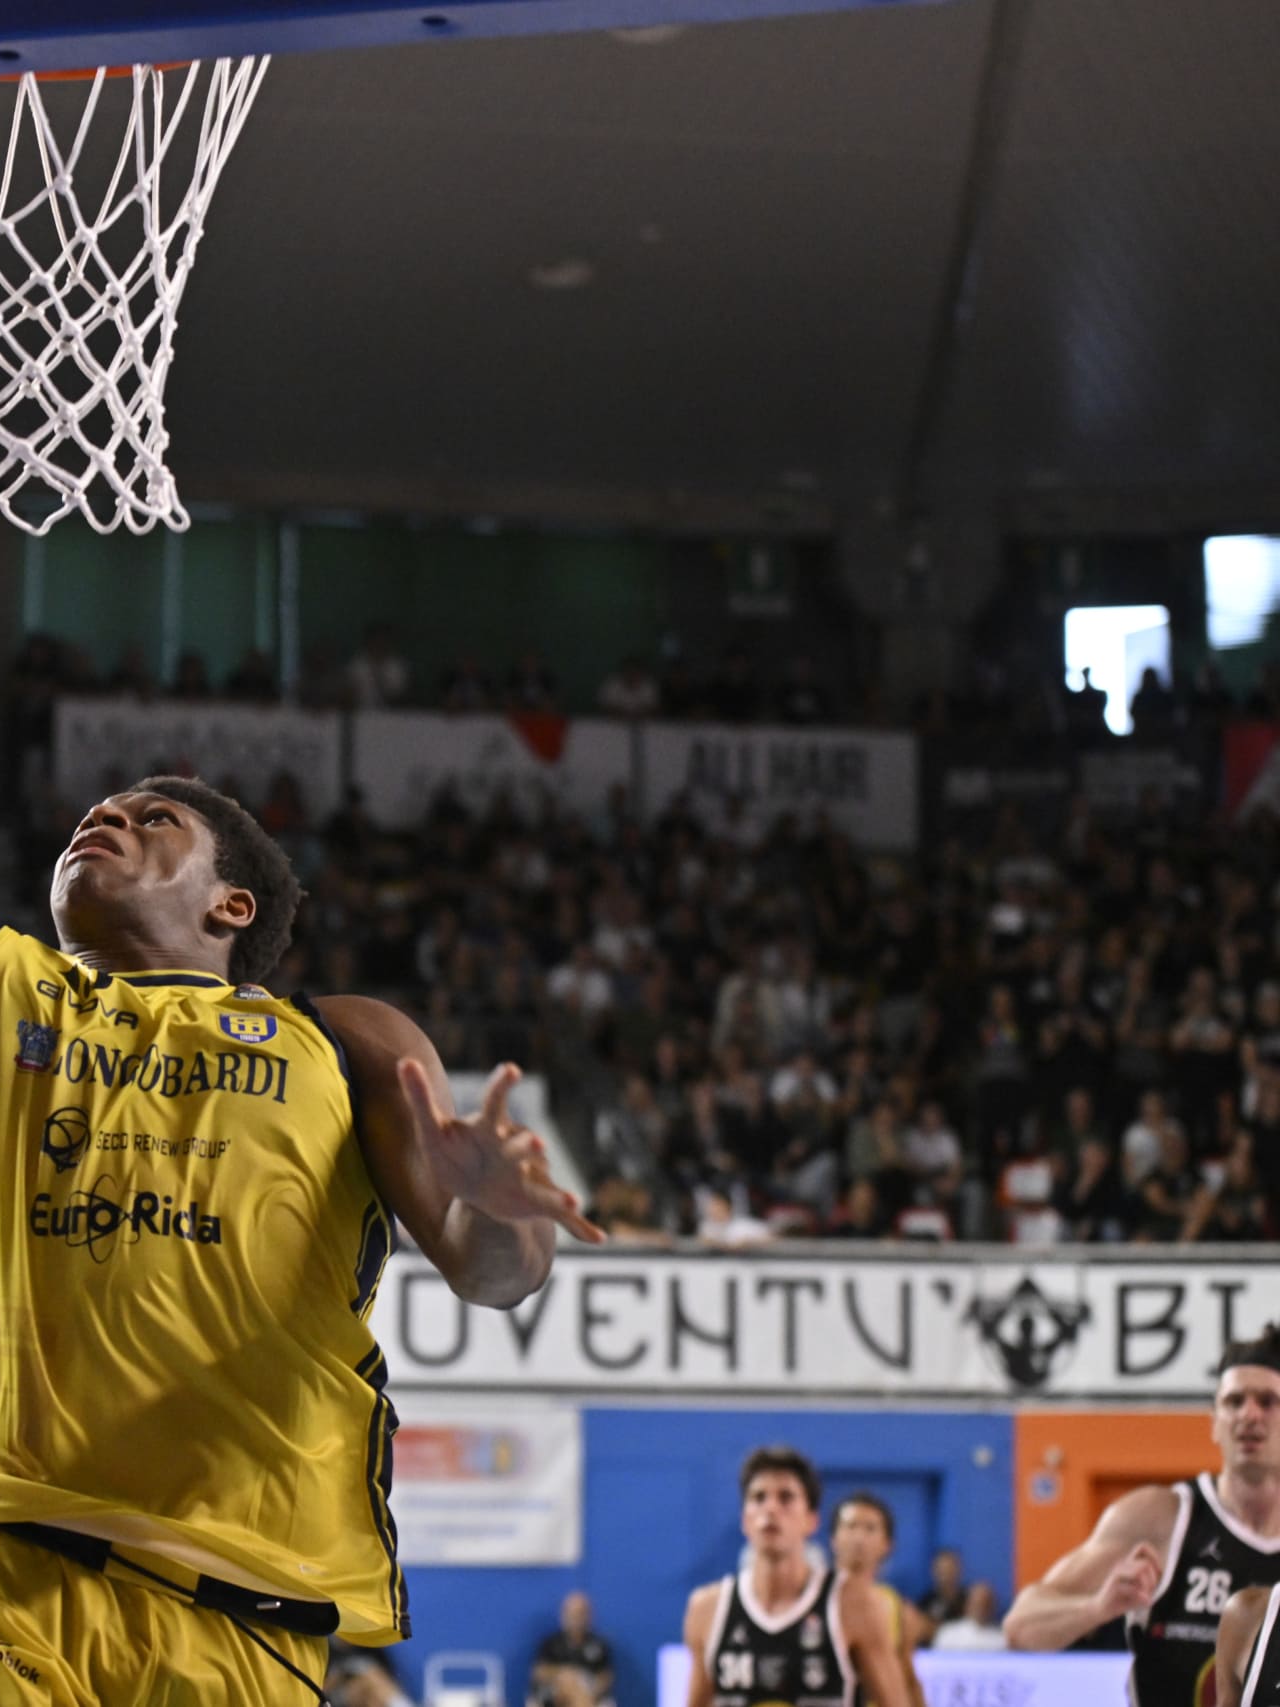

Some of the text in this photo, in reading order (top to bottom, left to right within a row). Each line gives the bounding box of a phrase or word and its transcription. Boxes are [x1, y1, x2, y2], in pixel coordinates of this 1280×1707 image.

[53, 1037, 289, 1104] ONGOBARDI
[134, 1133, 179, 1157] RENEW
[182, 1136, 226, 1159] GROUP
[1185, 1567, 1232, 1614] 26
